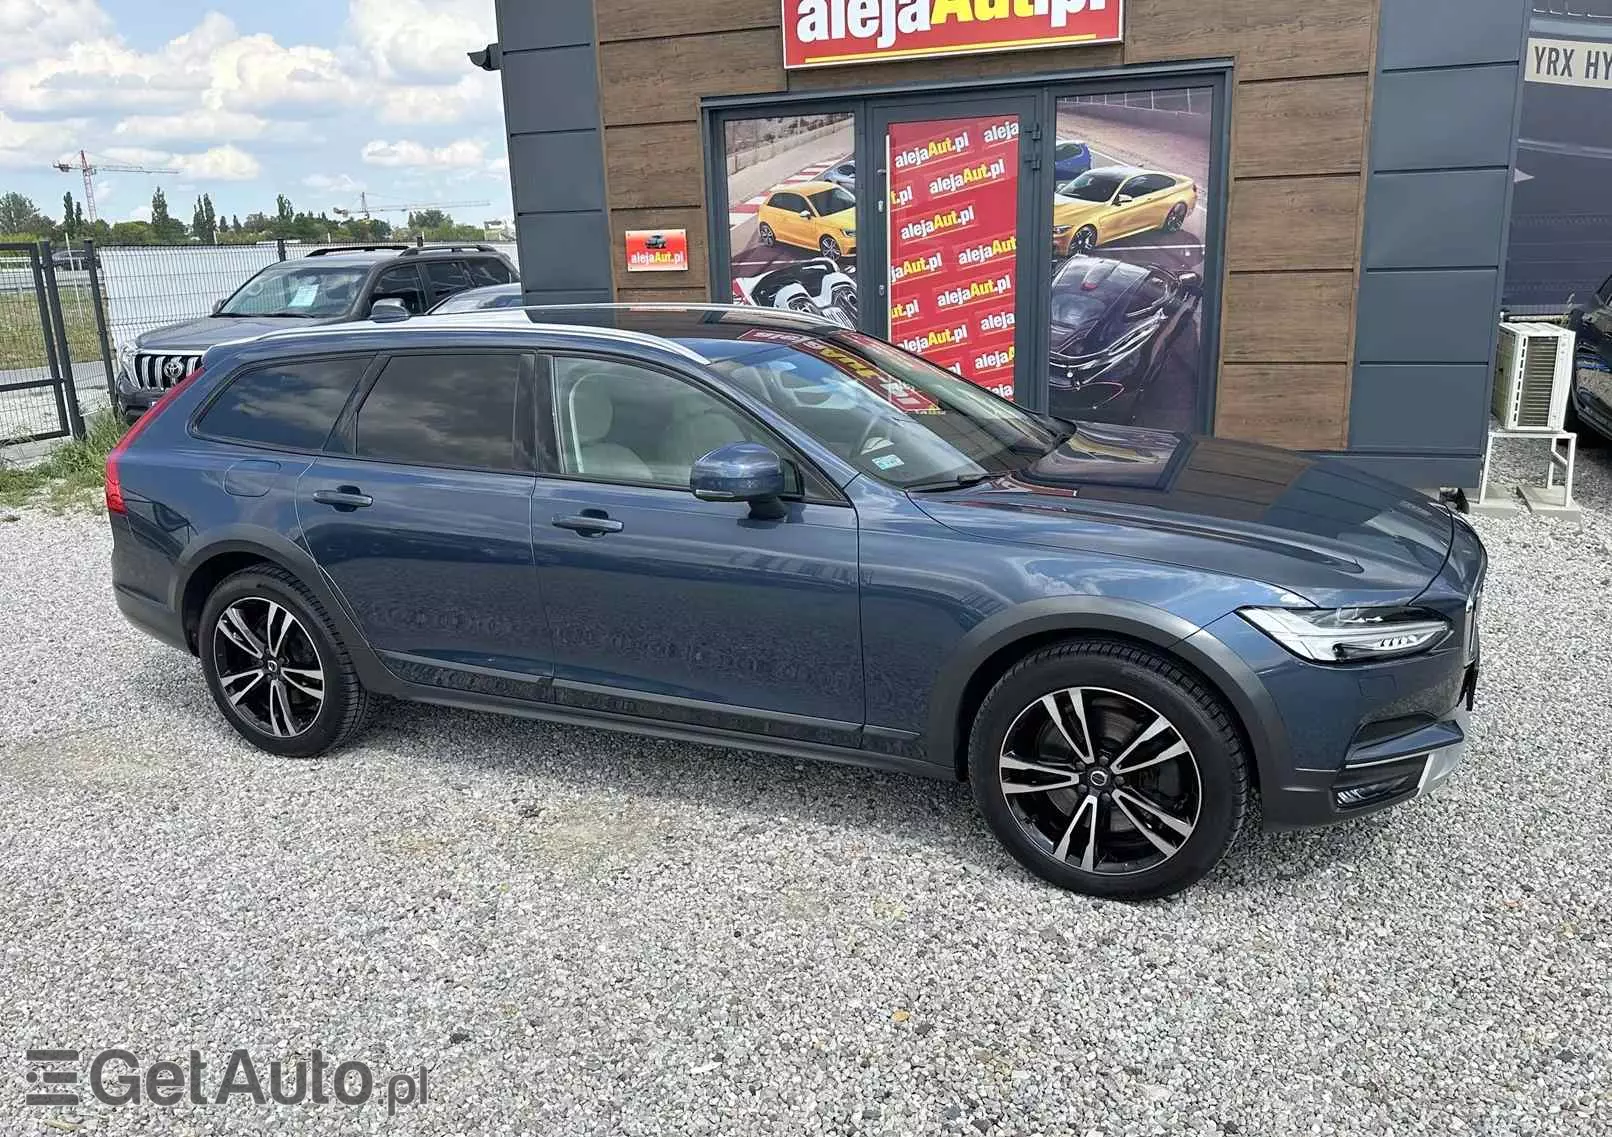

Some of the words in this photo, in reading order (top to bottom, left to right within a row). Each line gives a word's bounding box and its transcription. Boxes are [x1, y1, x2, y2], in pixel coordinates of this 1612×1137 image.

[1534, 45, 1575, 78] YRX
[895, 132, 969, 168] alejaAut.pl
[929, 159, 1005, 194] alejaAut.pl
[900, 205, 976, 240] alejaAut.pl
[630, 250, 685, 265] alejaAut.pl
[937, 274, 1011, 307] alejaAut.pl
[980, 311, 1016, 332] aleja
